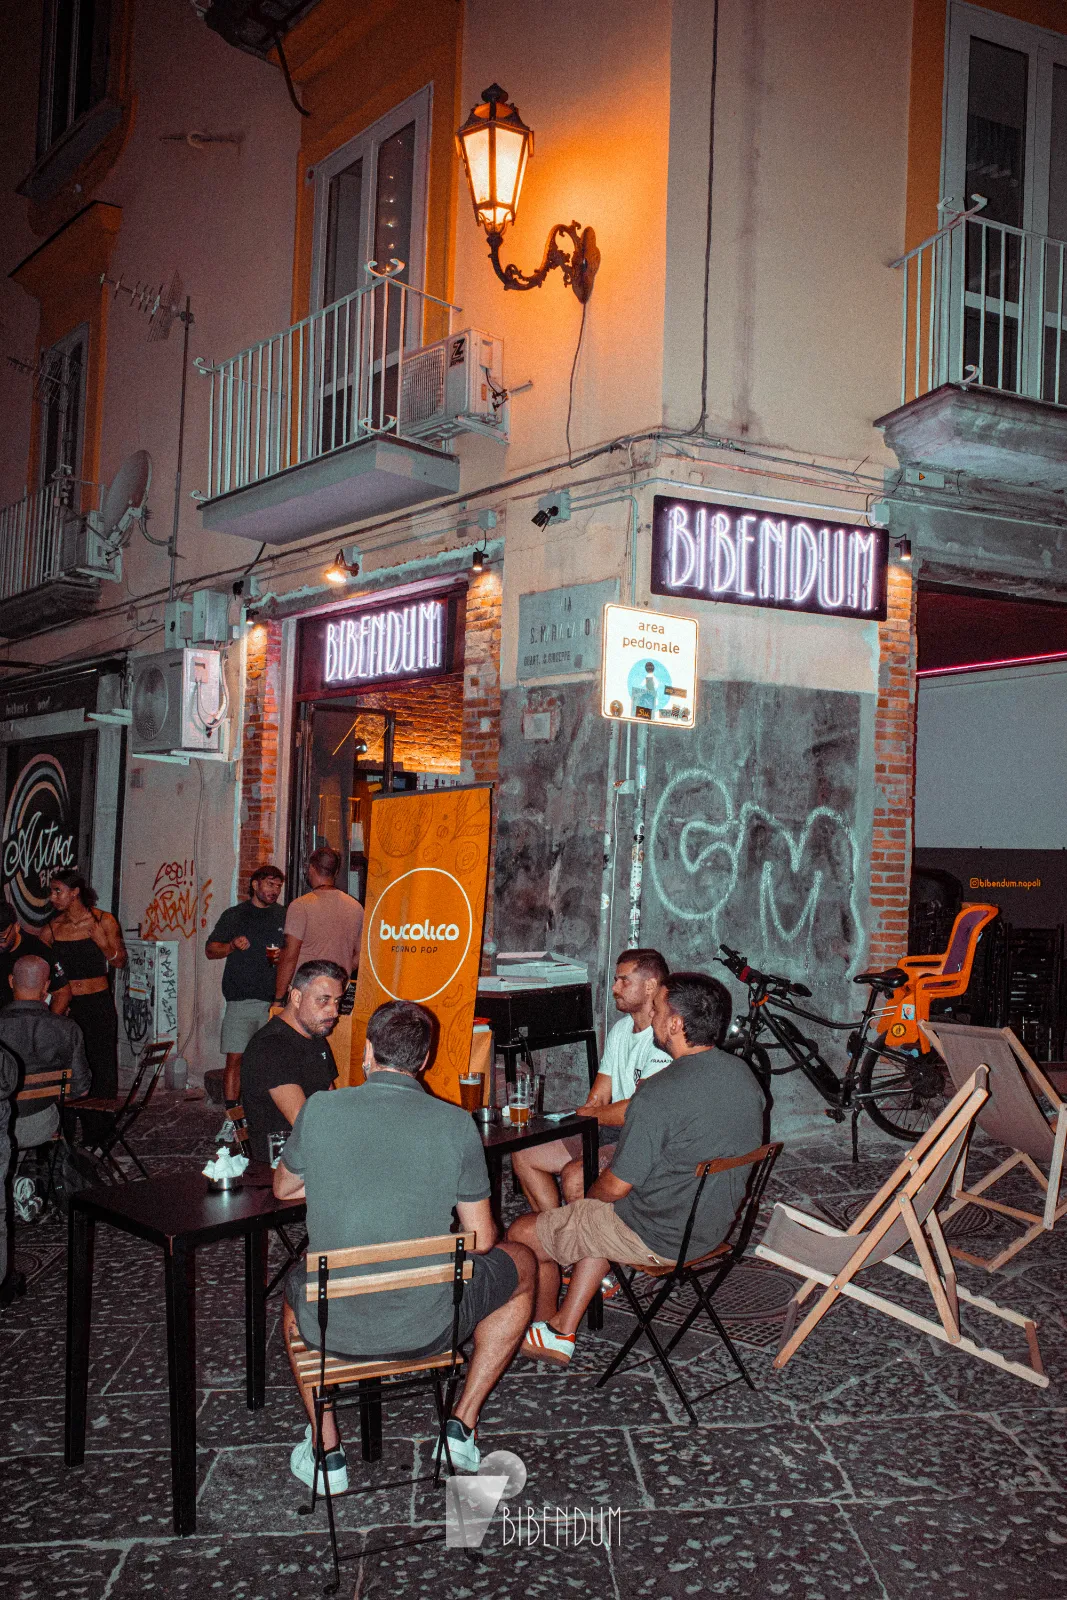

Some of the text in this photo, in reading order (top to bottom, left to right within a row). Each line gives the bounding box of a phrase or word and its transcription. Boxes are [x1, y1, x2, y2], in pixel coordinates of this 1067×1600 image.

[668, 506, 876, 611] BIBENDUM
[638, 621, 666, 635] area
[325, 601, 443, 683] BIBENDUM
[622, 637, 681, 655] pedonale
[4, 811, 74, 879] Astra
[379, 919, 460, 941] bucolico
[391, 945, 438, 954] FORNO POP
